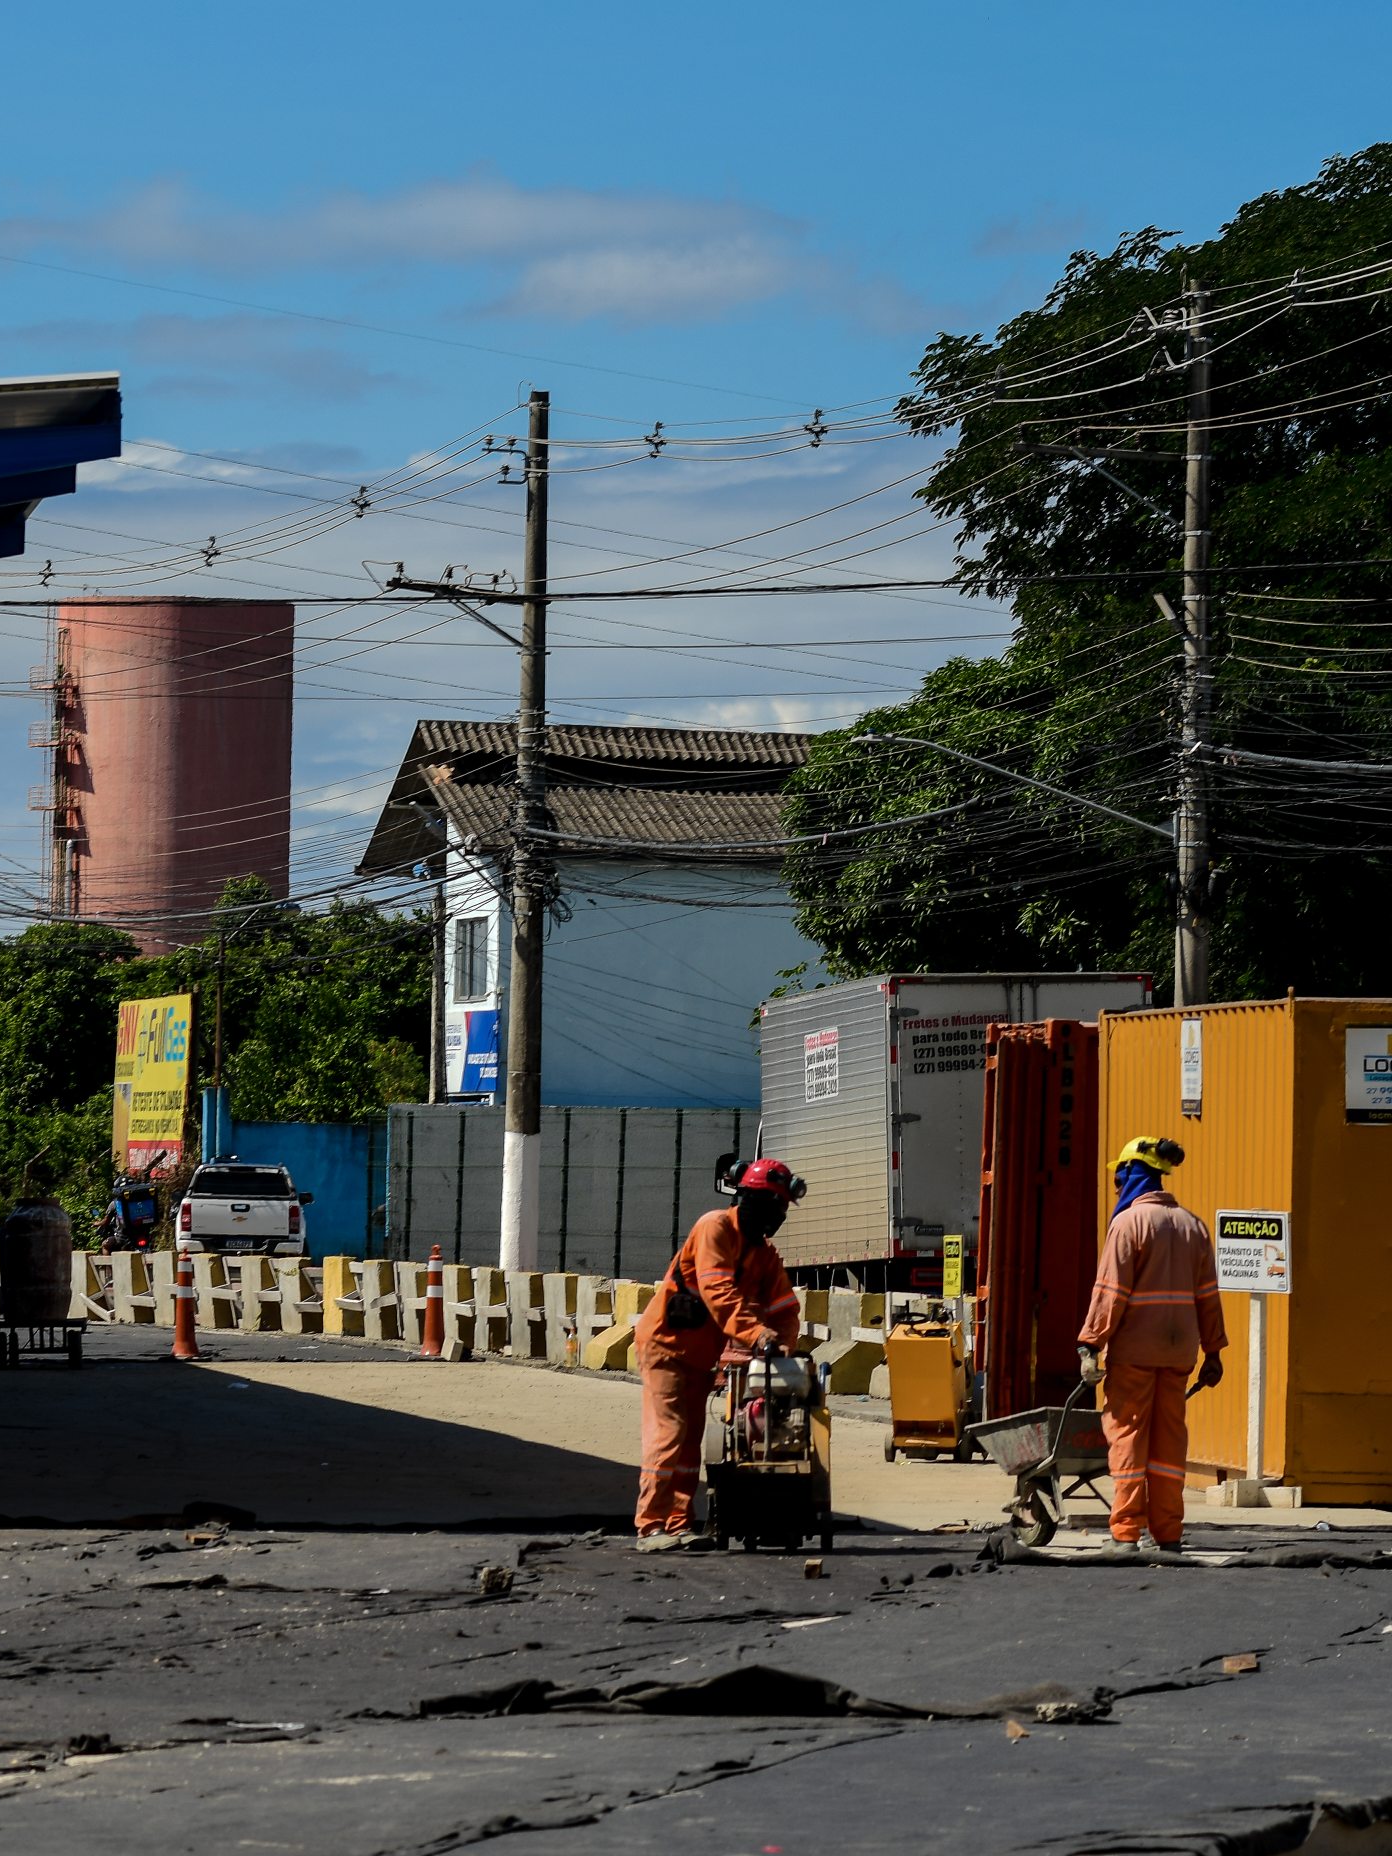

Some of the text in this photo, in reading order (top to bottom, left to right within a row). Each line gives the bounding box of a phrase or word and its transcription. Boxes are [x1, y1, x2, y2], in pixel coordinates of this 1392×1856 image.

[903, 1018, 940, 1030] Fretes
[942, 1018, 949, 1028] e
[912, 1033, 940, 1046] para
[941, 1030, 968, 1042] todo
[913, 1047, 936, 1059] (27)
[913, 1062, 936, 1074] (27)
[1223, 1220, 1279, 1239] ATENÇÃO
[1218, 1245, 1264, 1256] TRÂNSITO DE
[1220, 1257, 1261, 1268] VEÍCULOS E
[1222, 1268, 1259, 1279] MÁQUINAS
